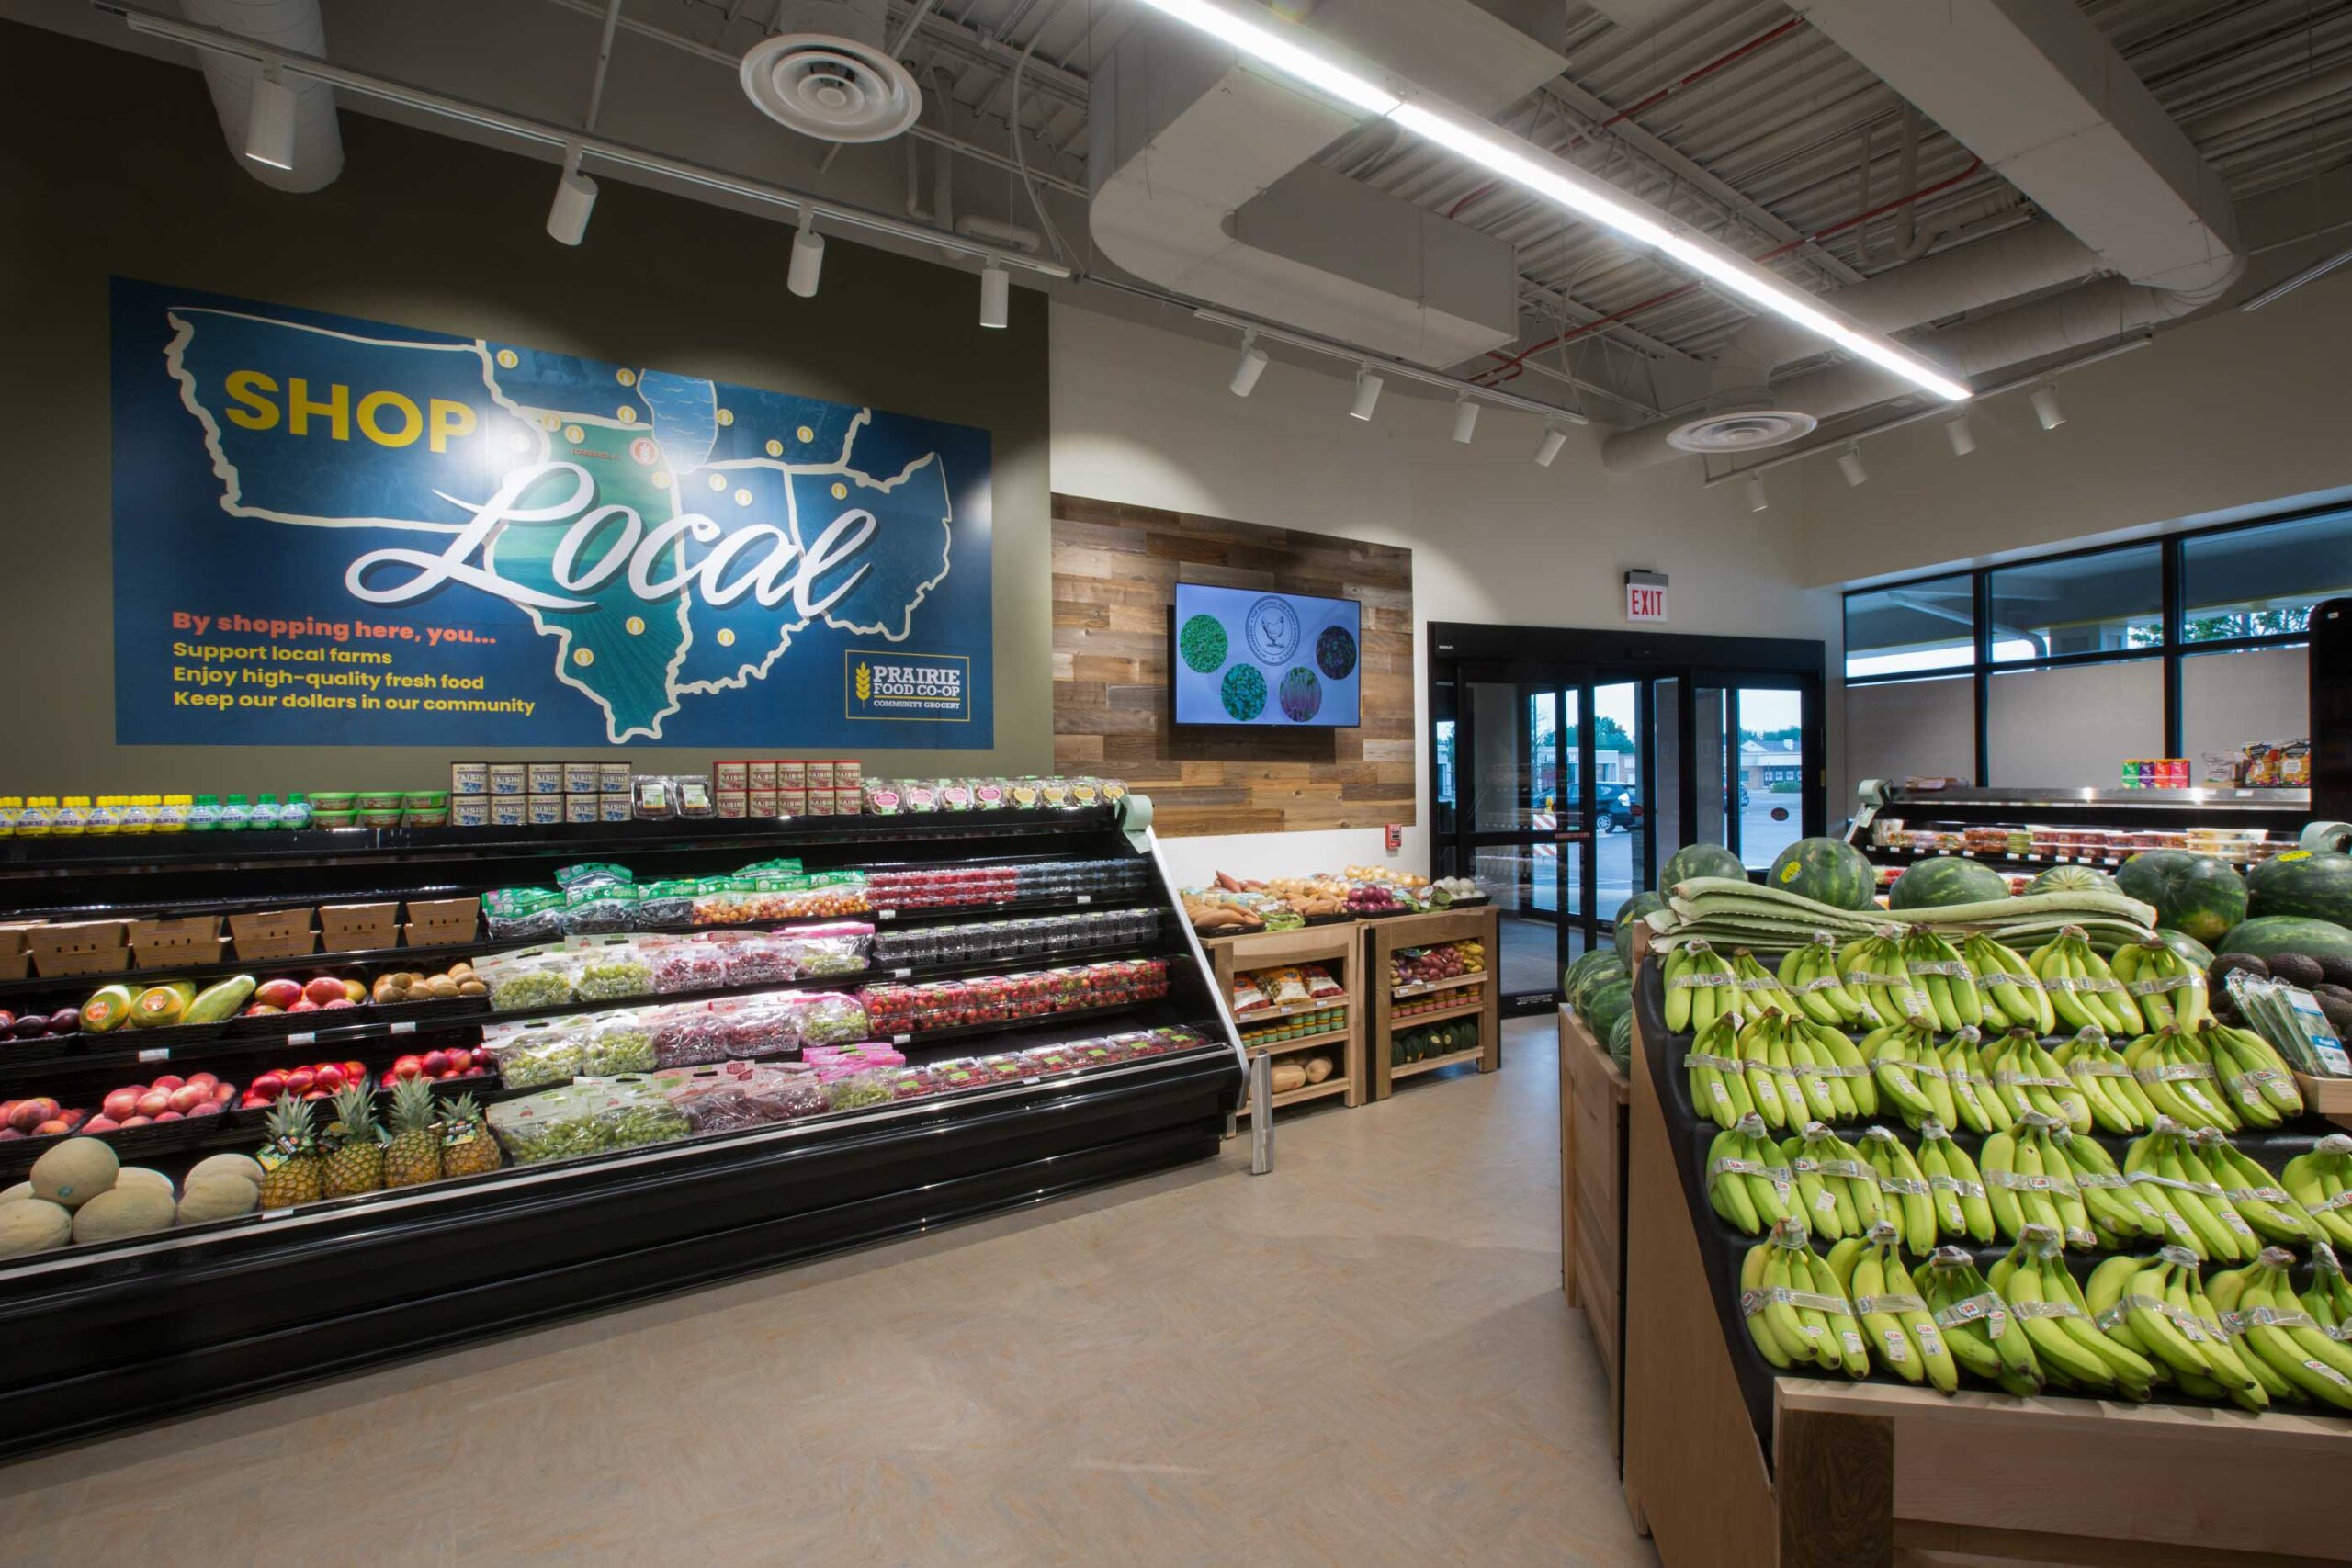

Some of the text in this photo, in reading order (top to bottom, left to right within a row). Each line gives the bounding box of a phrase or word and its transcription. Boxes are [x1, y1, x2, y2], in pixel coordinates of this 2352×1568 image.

[224, 370, 478, 453] SHOP
[345, 461, 876, 618] Local
[1632, 589, 1662, 616] EXIT
[173, 612, 497, 646] By shopping here, you...
[173, 642, 393, 664] Support local farms
[174, 666, 484, 691] Enjoy high-quality fresh food
[873, 666, 960, 685] PRAIRIE
[874, 682, 960, 697] FOOD CO-OP
[174, 691, 535, 716] Keep our dollars in our community
[874, 700, 960, 709] COMMUNITY GROCERY
